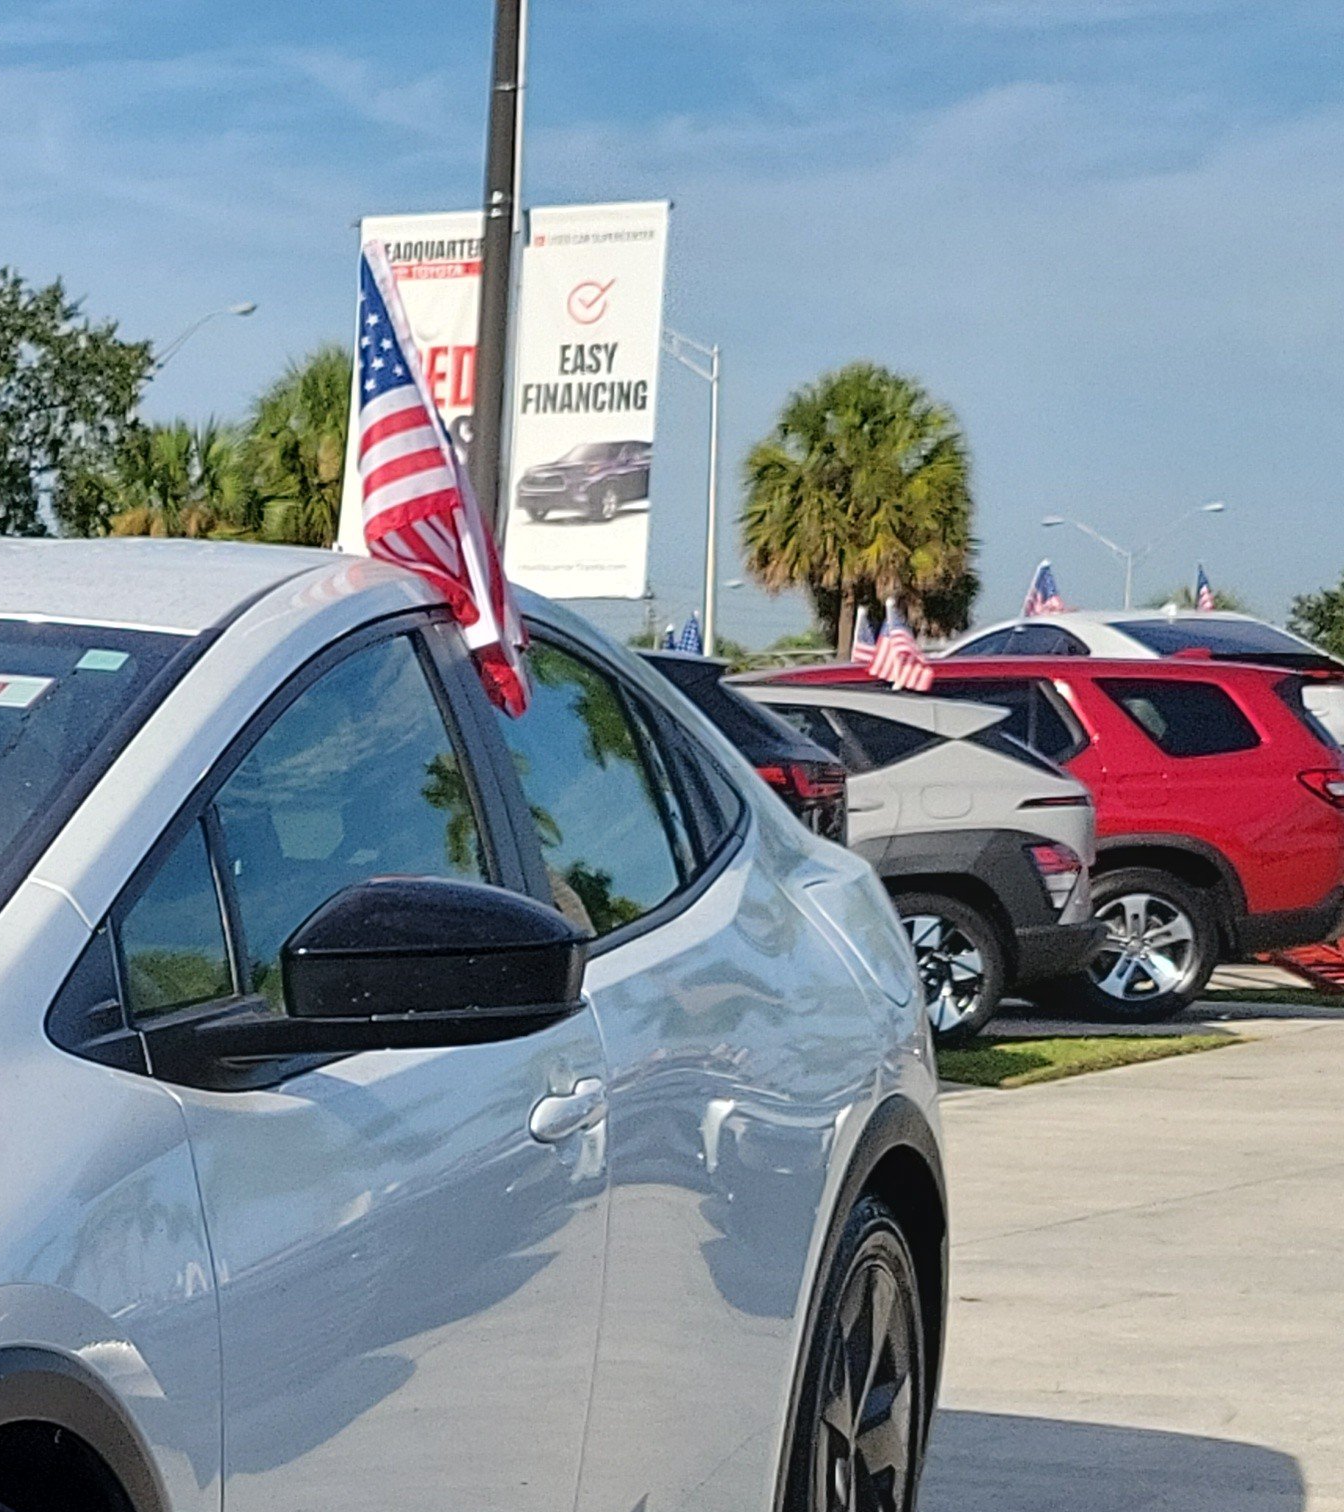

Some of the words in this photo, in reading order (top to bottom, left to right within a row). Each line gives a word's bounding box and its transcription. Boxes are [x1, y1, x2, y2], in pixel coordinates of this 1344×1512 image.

[384, 238, 483, 264] EADQUARTE
[558, 342, 618, 376] EASY
[521, 379, 648, 414] FINANCING
